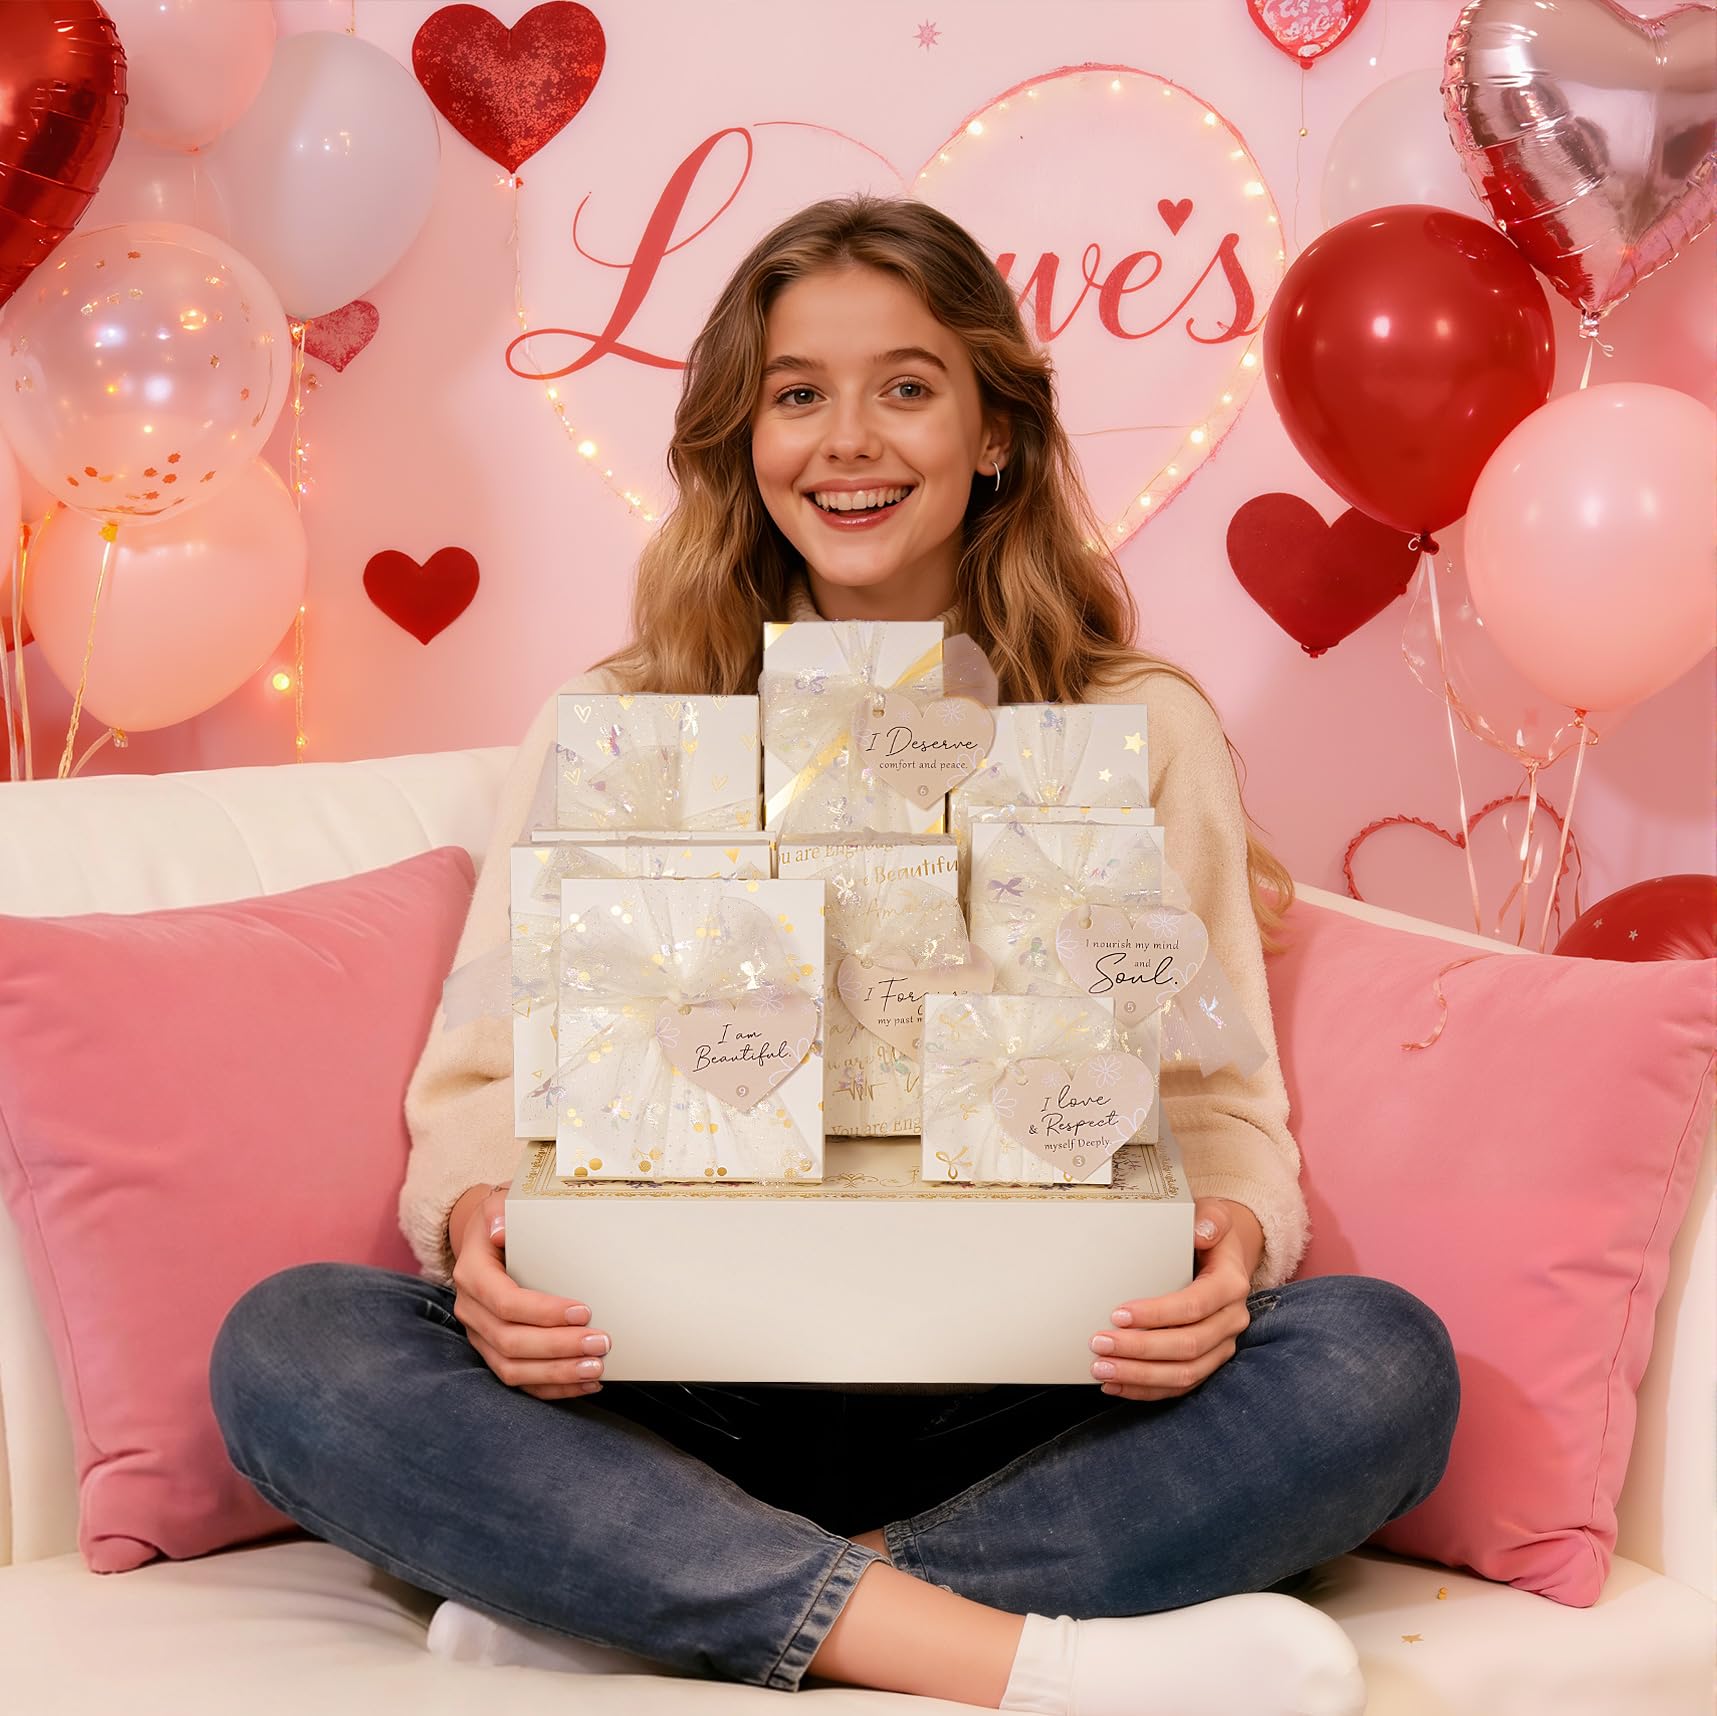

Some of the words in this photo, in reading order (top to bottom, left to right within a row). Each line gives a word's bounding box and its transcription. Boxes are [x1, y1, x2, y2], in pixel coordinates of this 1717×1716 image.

[865, 732, 881, 752] I
[885, 726, 978, 757] Deserve
[879, 759, 916, 770] comfort
[918, 759, 937, 770] and
[939, 760, 968, 772] peace.
[795, 847, 820, 863] are
[1086, 938, 1089, 948] I
[1093, 938, 1132, 949] nourish
[1135, 941, 1150, 952] my
[1153, 939, 1180, 950] mind
[1134, 959, 1151, 968] and
[1088, 952, 1178, 994] Soul.
[863, 986, 875, 1002] I
[878, 1017, 892, 1028] my
[894, 1015, 914, 1027] past
[718, 1023, 732, 1044] I
[735, 1031, 762, 1040] am
[692, 1040, 792, 1073] Beautiful.
[1040, 1097, 1052, 1113] I
[1058, 1084, 1112, 1110] love
[1028, 1124, 1039, 1135] &
[1041, 1110, 1119, 1137] Respect
[1043, 1138, 1076, 1153] myself
